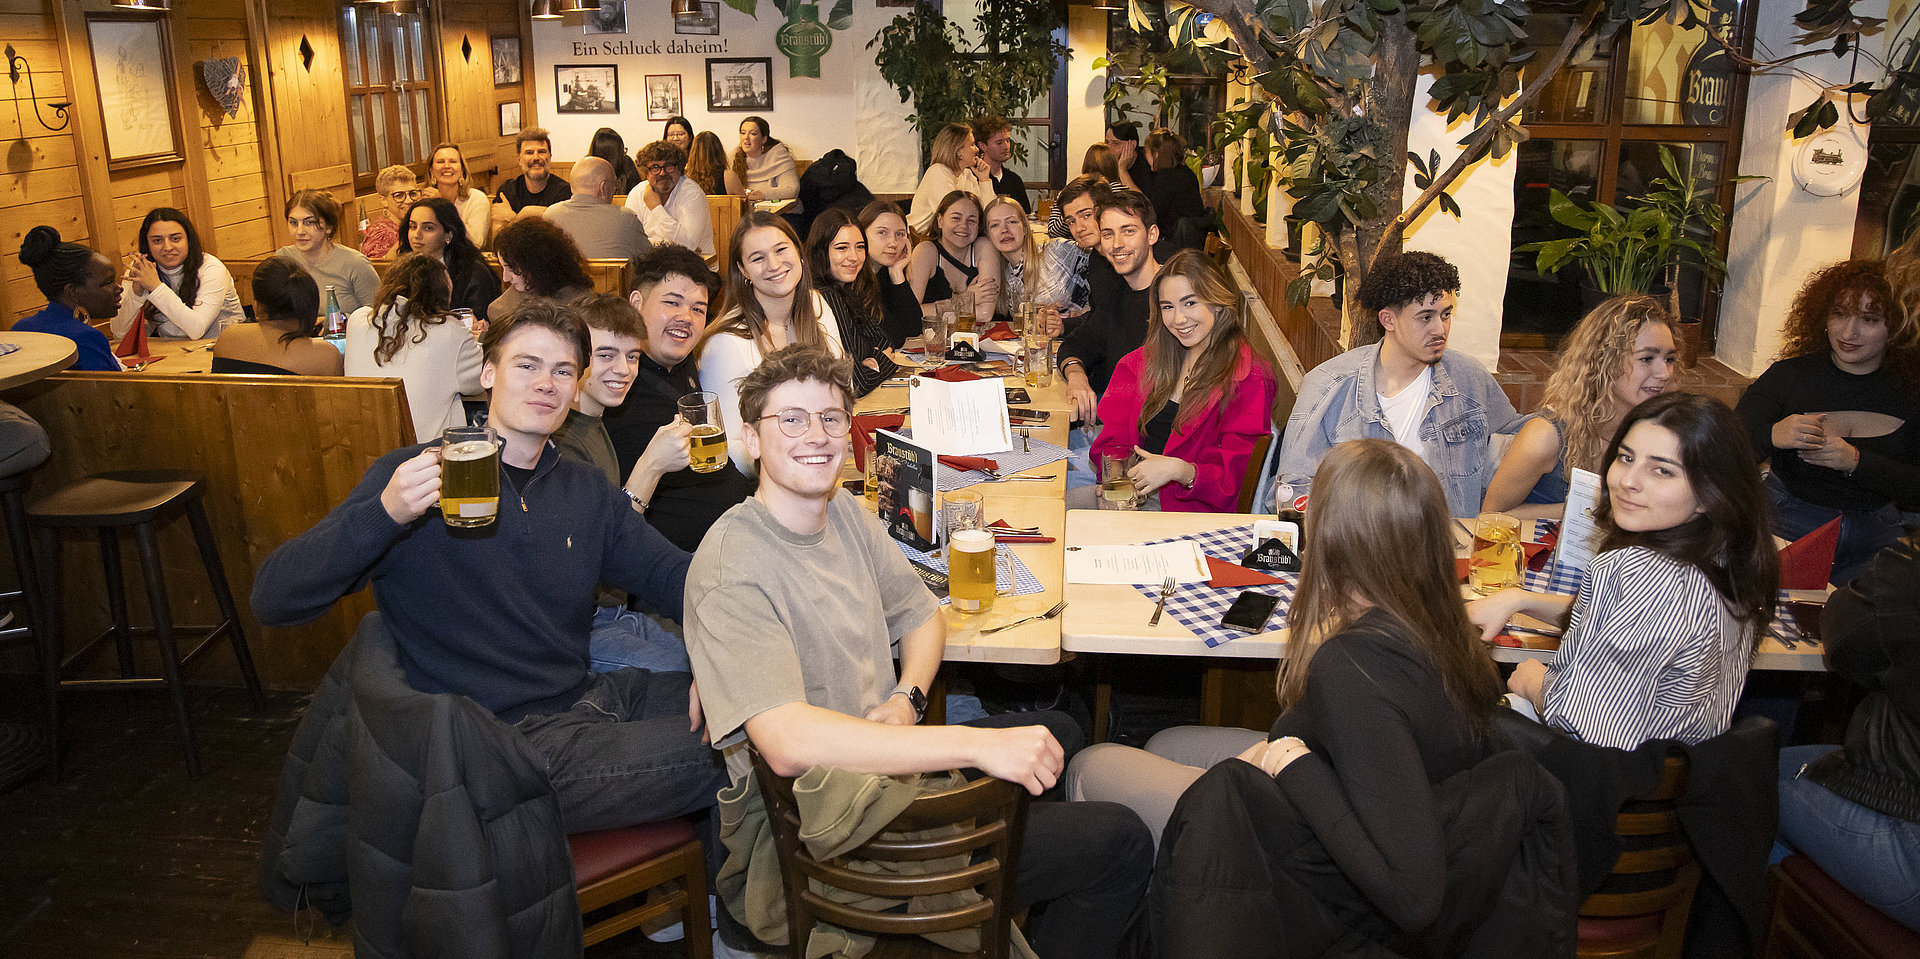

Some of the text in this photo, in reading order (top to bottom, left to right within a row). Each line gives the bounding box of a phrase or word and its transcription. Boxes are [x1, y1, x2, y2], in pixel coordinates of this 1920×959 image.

[573, 39, 728, 56] Ein Schluck daheim!
[1256, 553, 1292, 565] Braustüb'l
